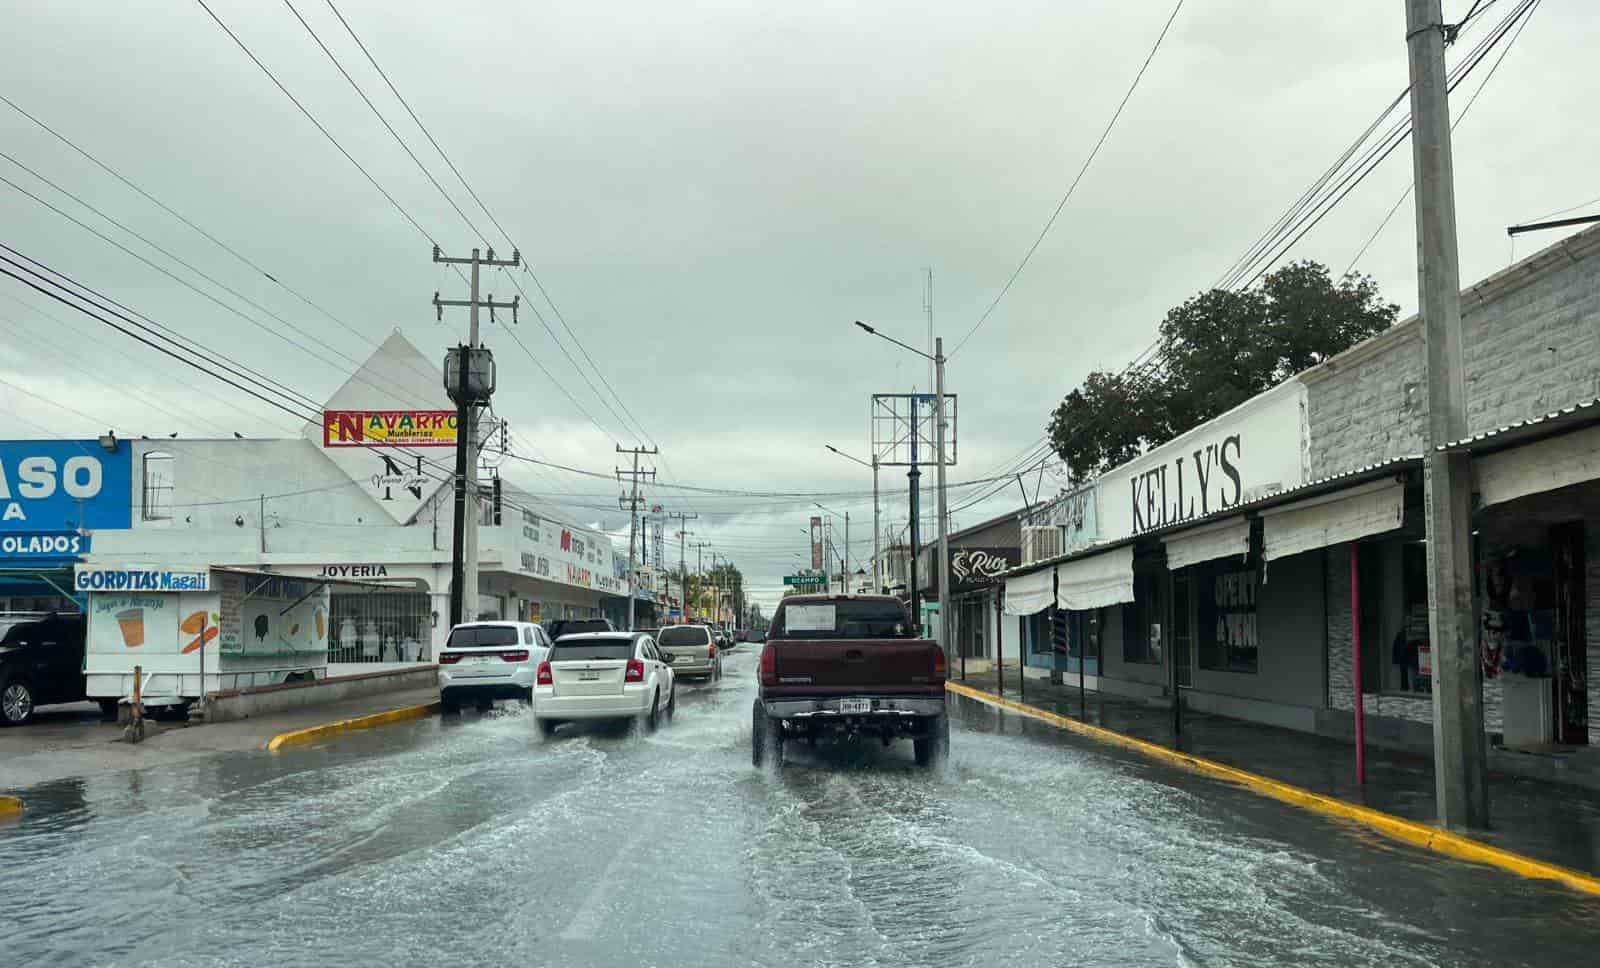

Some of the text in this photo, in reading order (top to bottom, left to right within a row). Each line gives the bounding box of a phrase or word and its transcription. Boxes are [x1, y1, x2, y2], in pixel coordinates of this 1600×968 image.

[0, 456, 103, 499] SO
[1131, 433, 1241, 534] KELLY'S
[77, 571, 206, 590] GORDITAS Magali
[317, 565, 388, 577] JOYERIA
